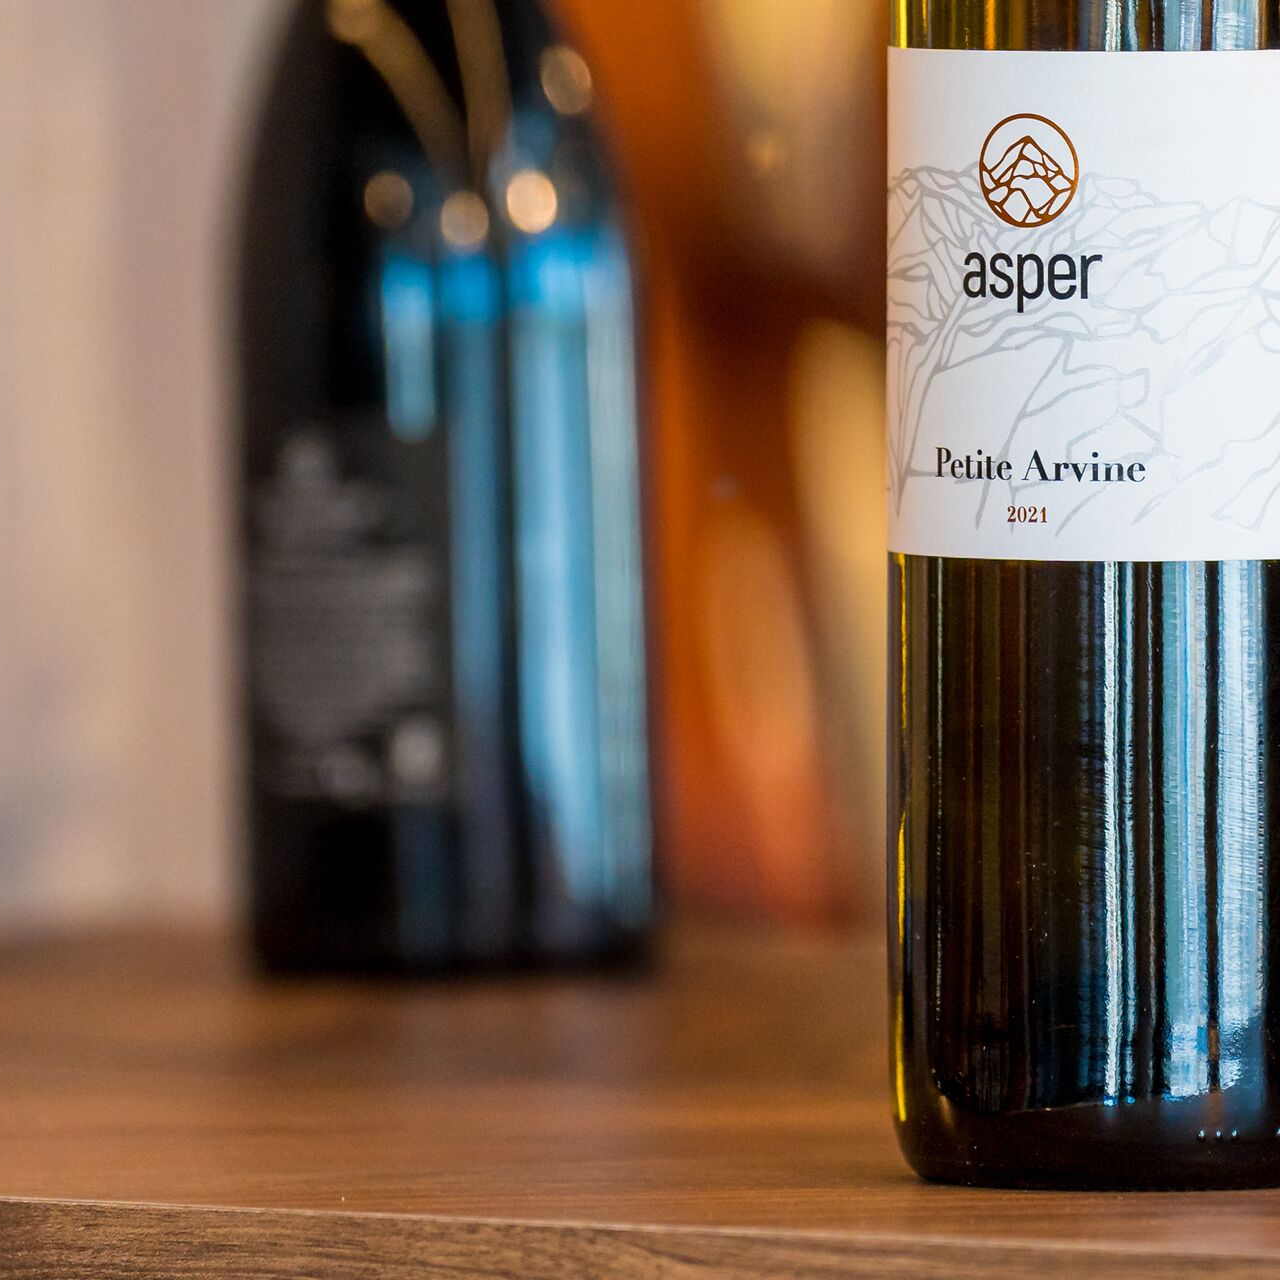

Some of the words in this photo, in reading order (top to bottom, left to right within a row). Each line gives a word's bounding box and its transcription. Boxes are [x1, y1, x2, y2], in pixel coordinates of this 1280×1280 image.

[962, 251, 1103, 314] asper
[935, 446, 1013, 481] Petite
[1021, 449, 1146, 483] Arvine
[1006, 505, 1048, 523] 2021
